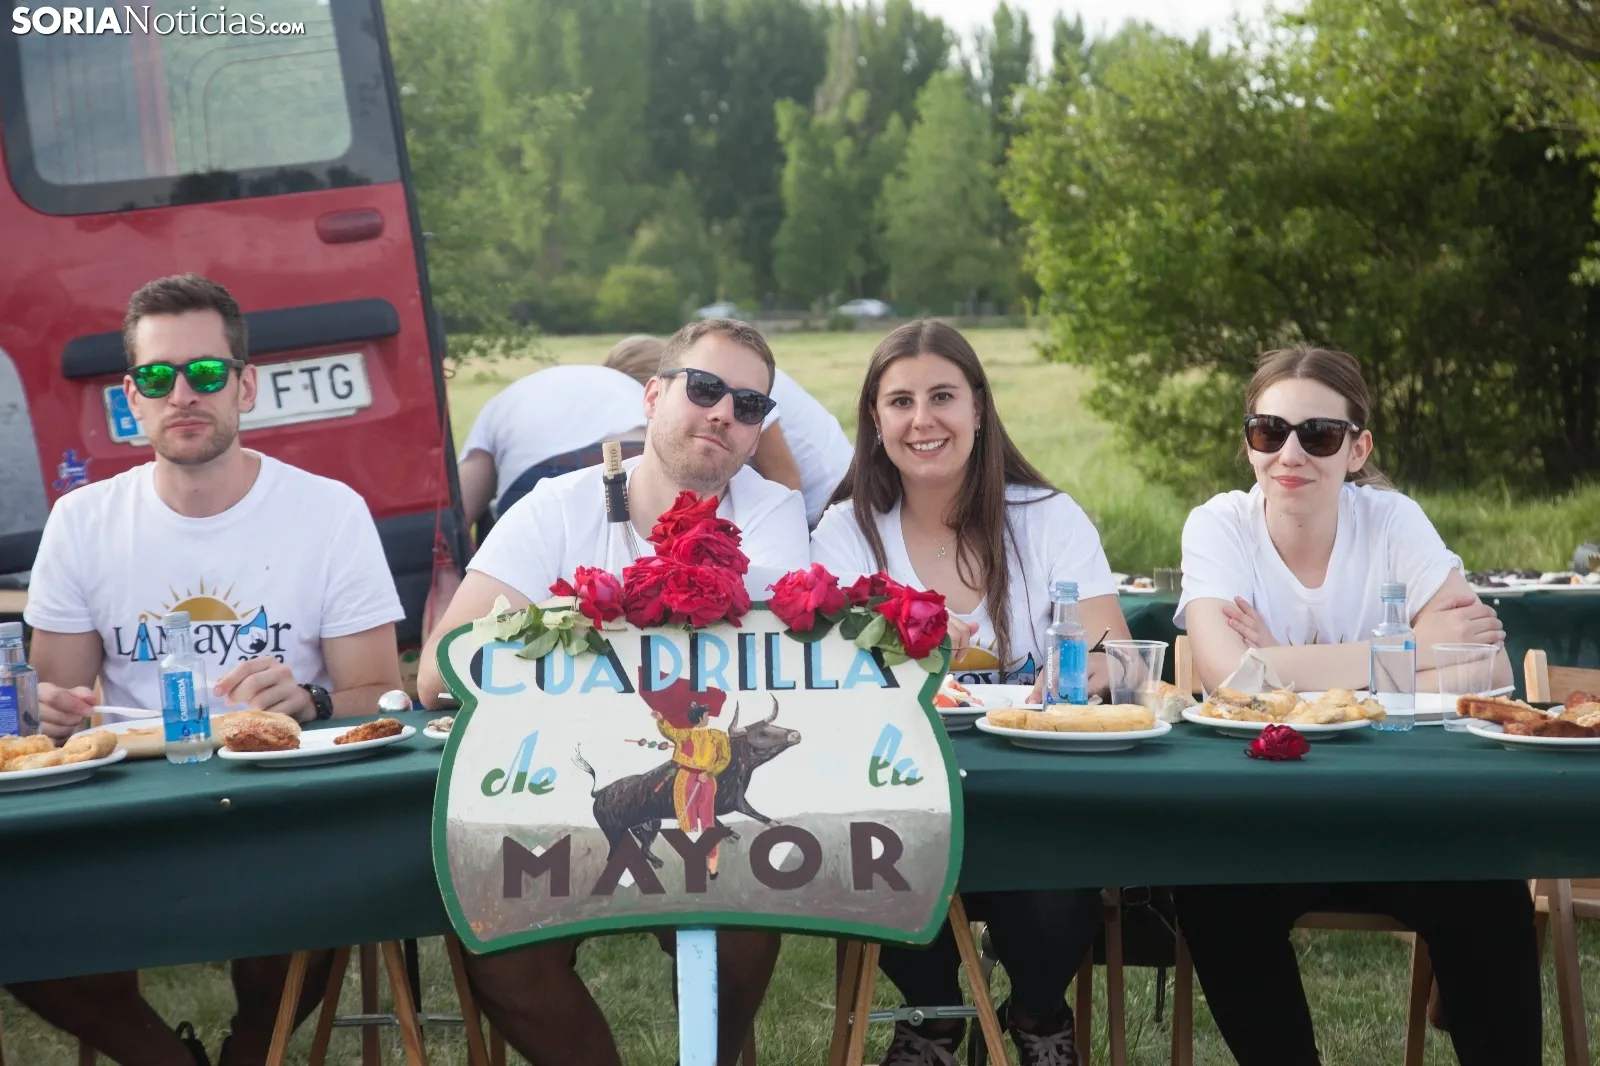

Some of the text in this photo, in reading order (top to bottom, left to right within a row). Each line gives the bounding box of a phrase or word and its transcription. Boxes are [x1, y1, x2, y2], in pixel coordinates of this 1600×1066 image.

[270, 363, 354, 409] FTG
[469, 631, 901, 695] CUADRILLA
[480, 723, 925, 797] de la
[502, 821, 911, 899] MAYOR
